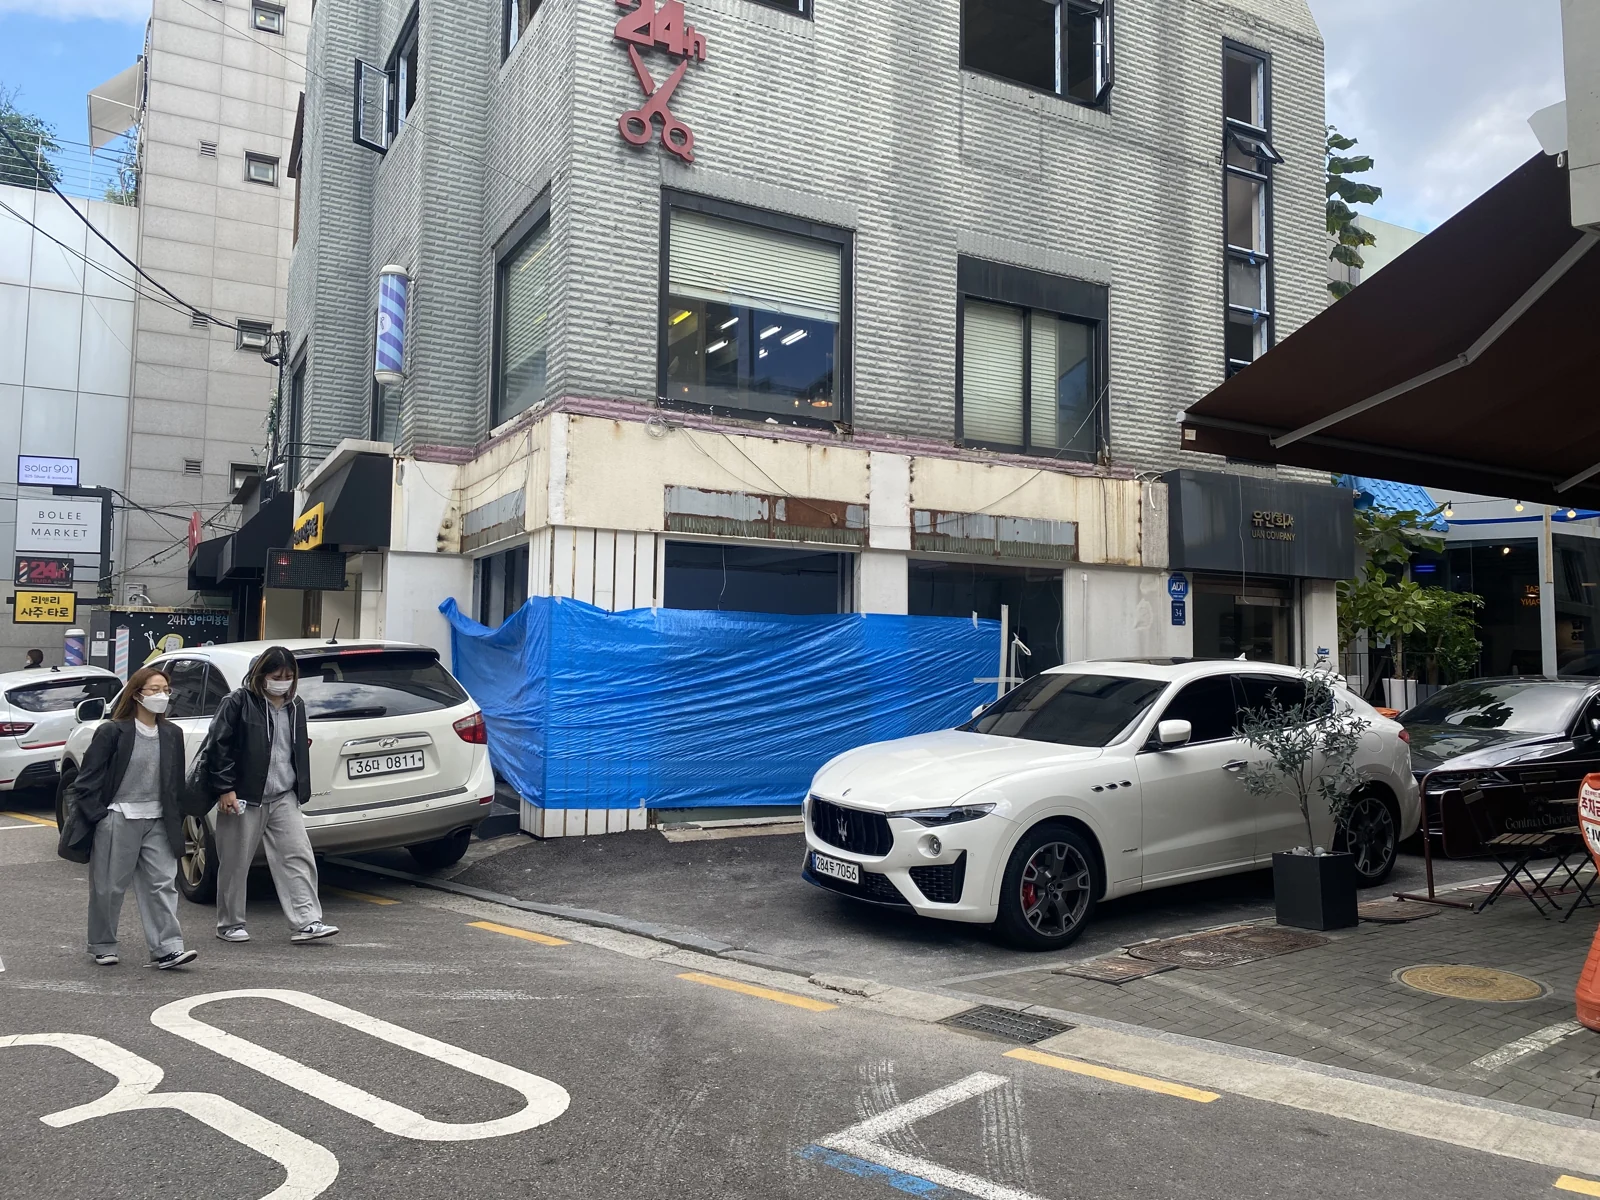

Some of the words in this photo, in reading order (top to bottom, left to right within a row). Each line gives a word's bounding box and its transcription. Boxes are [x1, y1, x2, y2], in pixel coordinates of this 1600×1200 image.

[613, 0, 707, 60] 24h
[24, 464, 51, 473] solar
[53, 464, 73, 474] 901
[38, 511, 82, 521] BOLEE
[31, 528, 88, 538] MARKET
[1251, 529, 1266, 539] UAN
[1266, 530, 1296, 542] COMPANY
[30, 561, 66, 579] 24h
[1171, 581, 1185, 592] ADT
[31, 595, 60, 605] 리앤리
[1174, 608, 1182, 617] 34
[167, 614, 187, 626] 24h
[187, 614, 230, 626] 심야미용실
[355, 759, 381, 774] 36다
[385, 754, 416, 770] 0811
